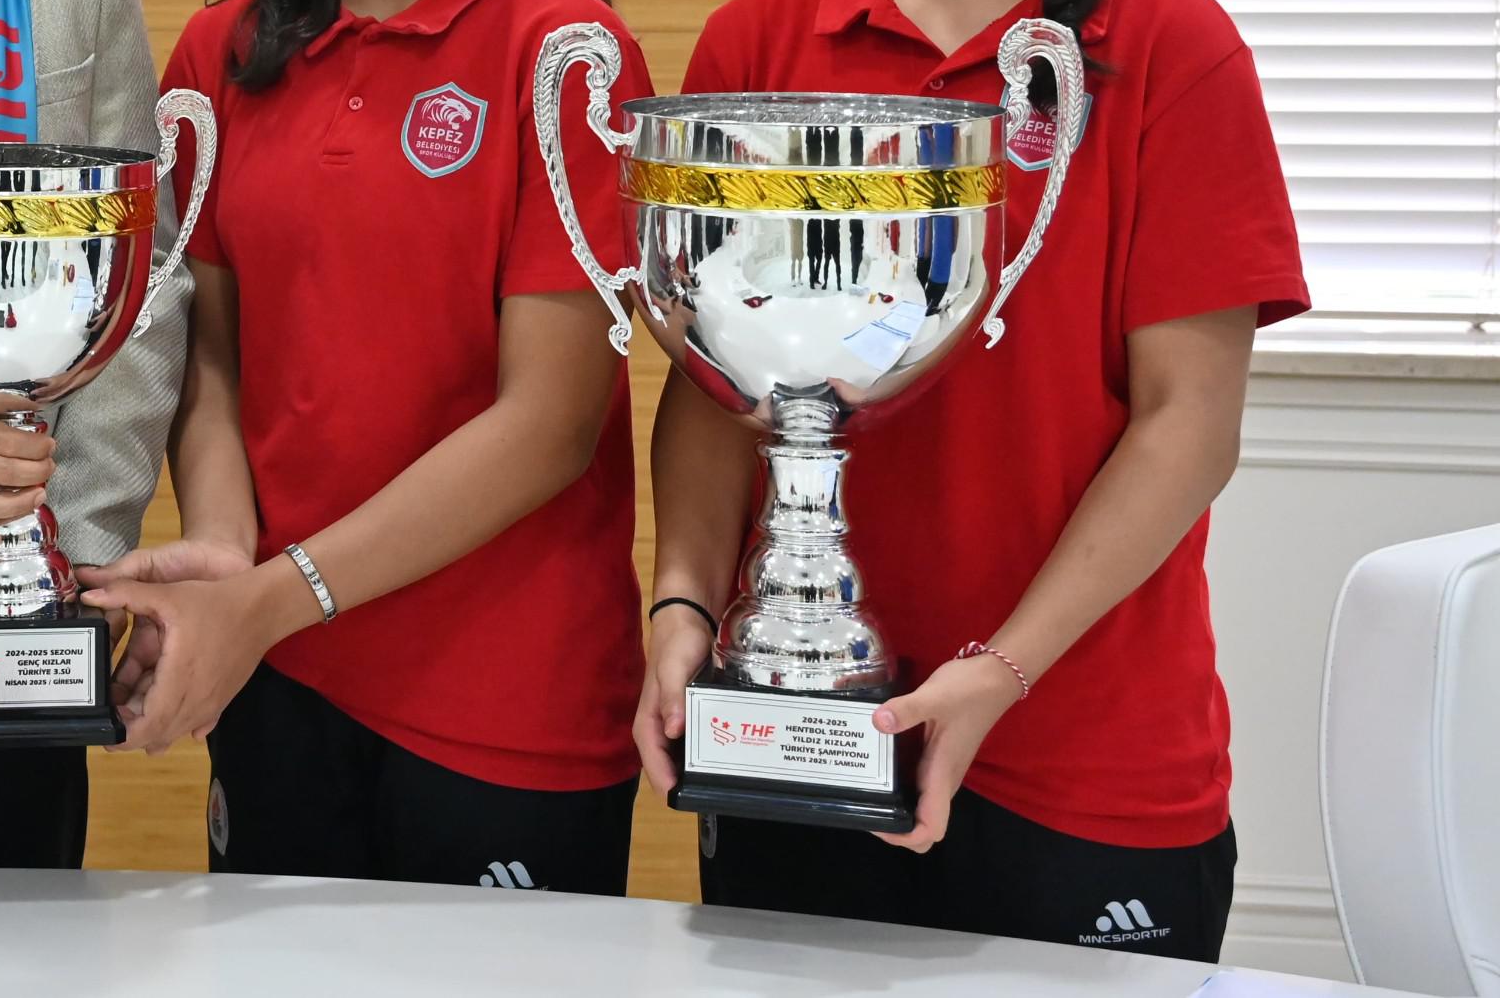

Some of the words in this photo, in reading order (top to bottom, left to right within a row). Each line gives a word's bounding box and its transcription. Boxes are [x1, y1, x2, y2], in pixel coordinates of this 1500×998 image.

[418, 126, 464, 144] KEPEZ
[1020, 120, 1056, 136] EPE
[415, 140, 460, 154] BELEDİYESİ
[5, 649, 48, 657] 2024-2025
[17, 659, 40, 667] GENÇ
[18, 667, 51, 675] TÜRKİYE
[53, 677, 84, 685] GİRESUN
[802, 716, 848, 727] 2024-2025
[740, 723, 776, 737] THF
[785, 725, 826, 735] HENTBOL
[829, 729, 864, 739] SEZONU
[792, 735, 821, 745] YILDIZ
[824, 739, 857, 748] KIZLAR
[780, 743, 816, 754] TÜRKİYE
[818, 748, 869, 759] ŞAMPİYONU
[783, 754, 807, 763] MAYIS
[808, 757, 828, 765] 2025
[834, 759, 866, 768] SAMSUN
[1078, 927, 1172, 944] MNCSPORTIF
